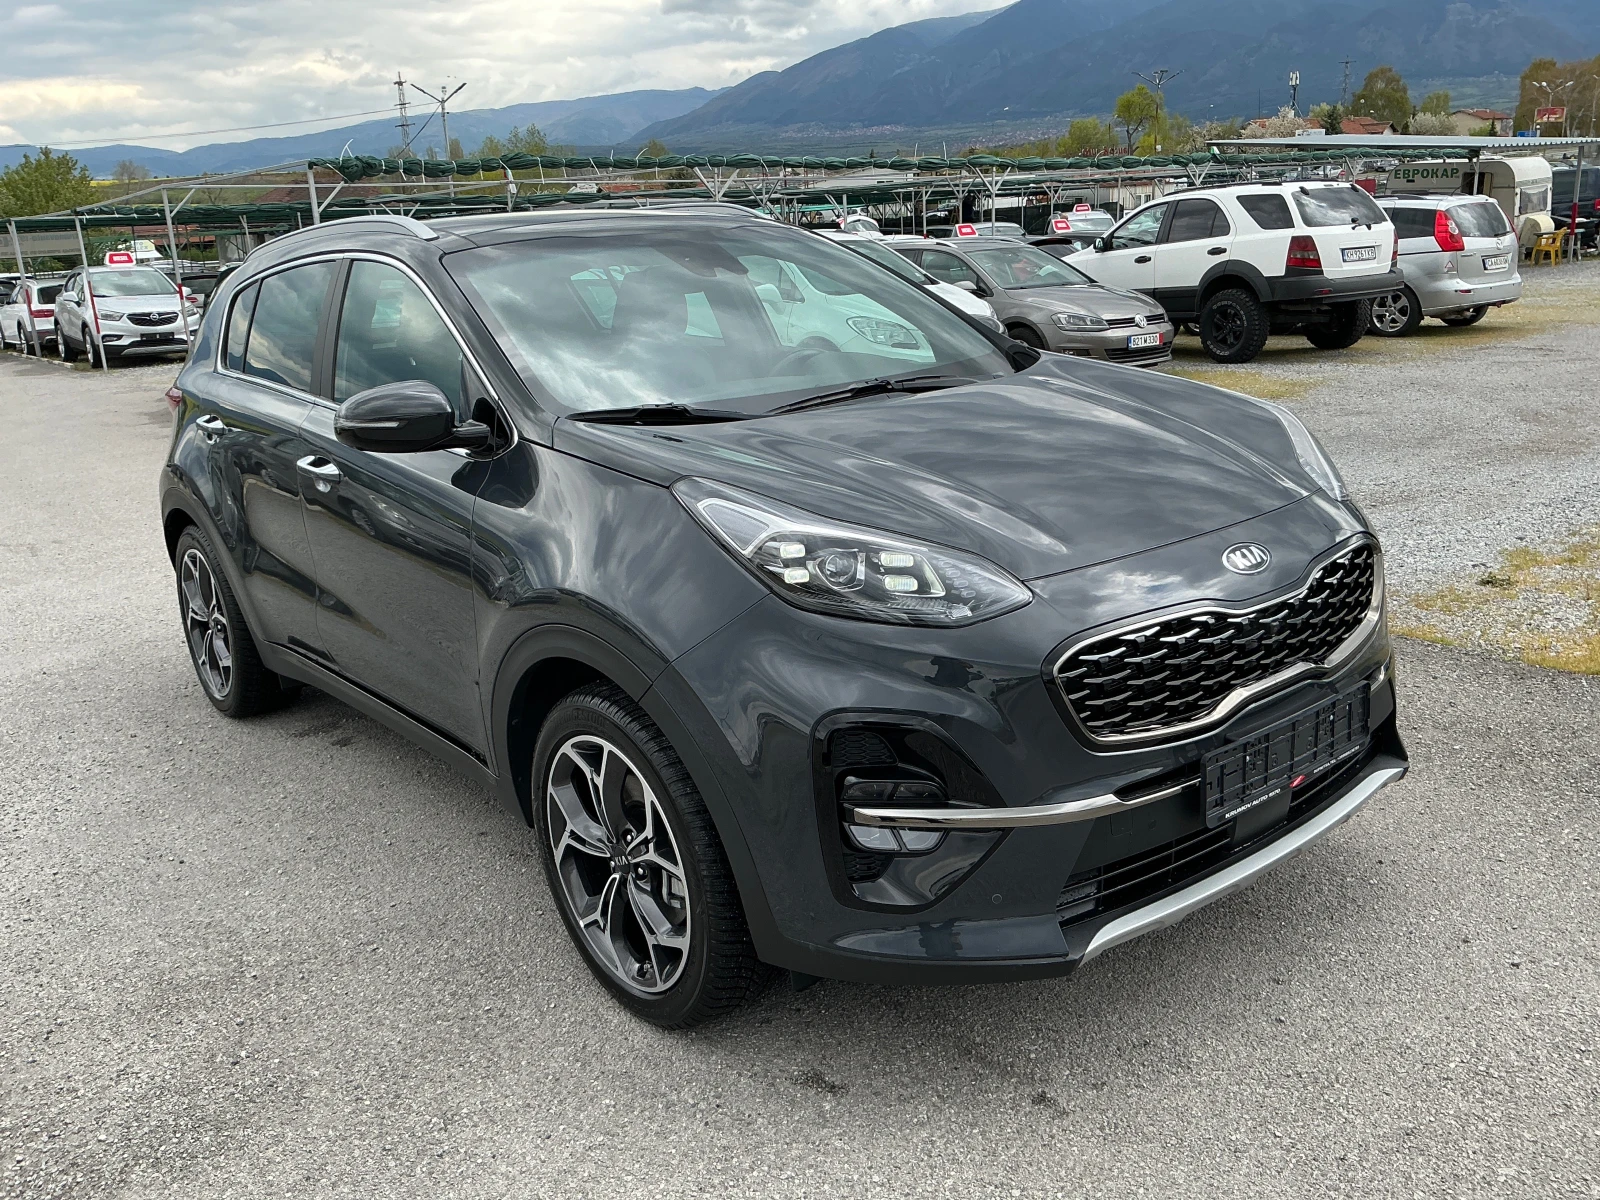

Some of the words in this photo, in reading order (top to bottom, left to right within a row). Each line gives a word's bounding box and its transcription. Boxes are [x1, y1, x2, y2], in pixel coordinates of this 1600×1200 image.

[1393, 168, 1460, 180] ЕВРОКАР
[1227, 545, 1268, 570] KIA
[1251, 794, 1269, 807] AUTO
[614, 855, 629, 866] KIA
